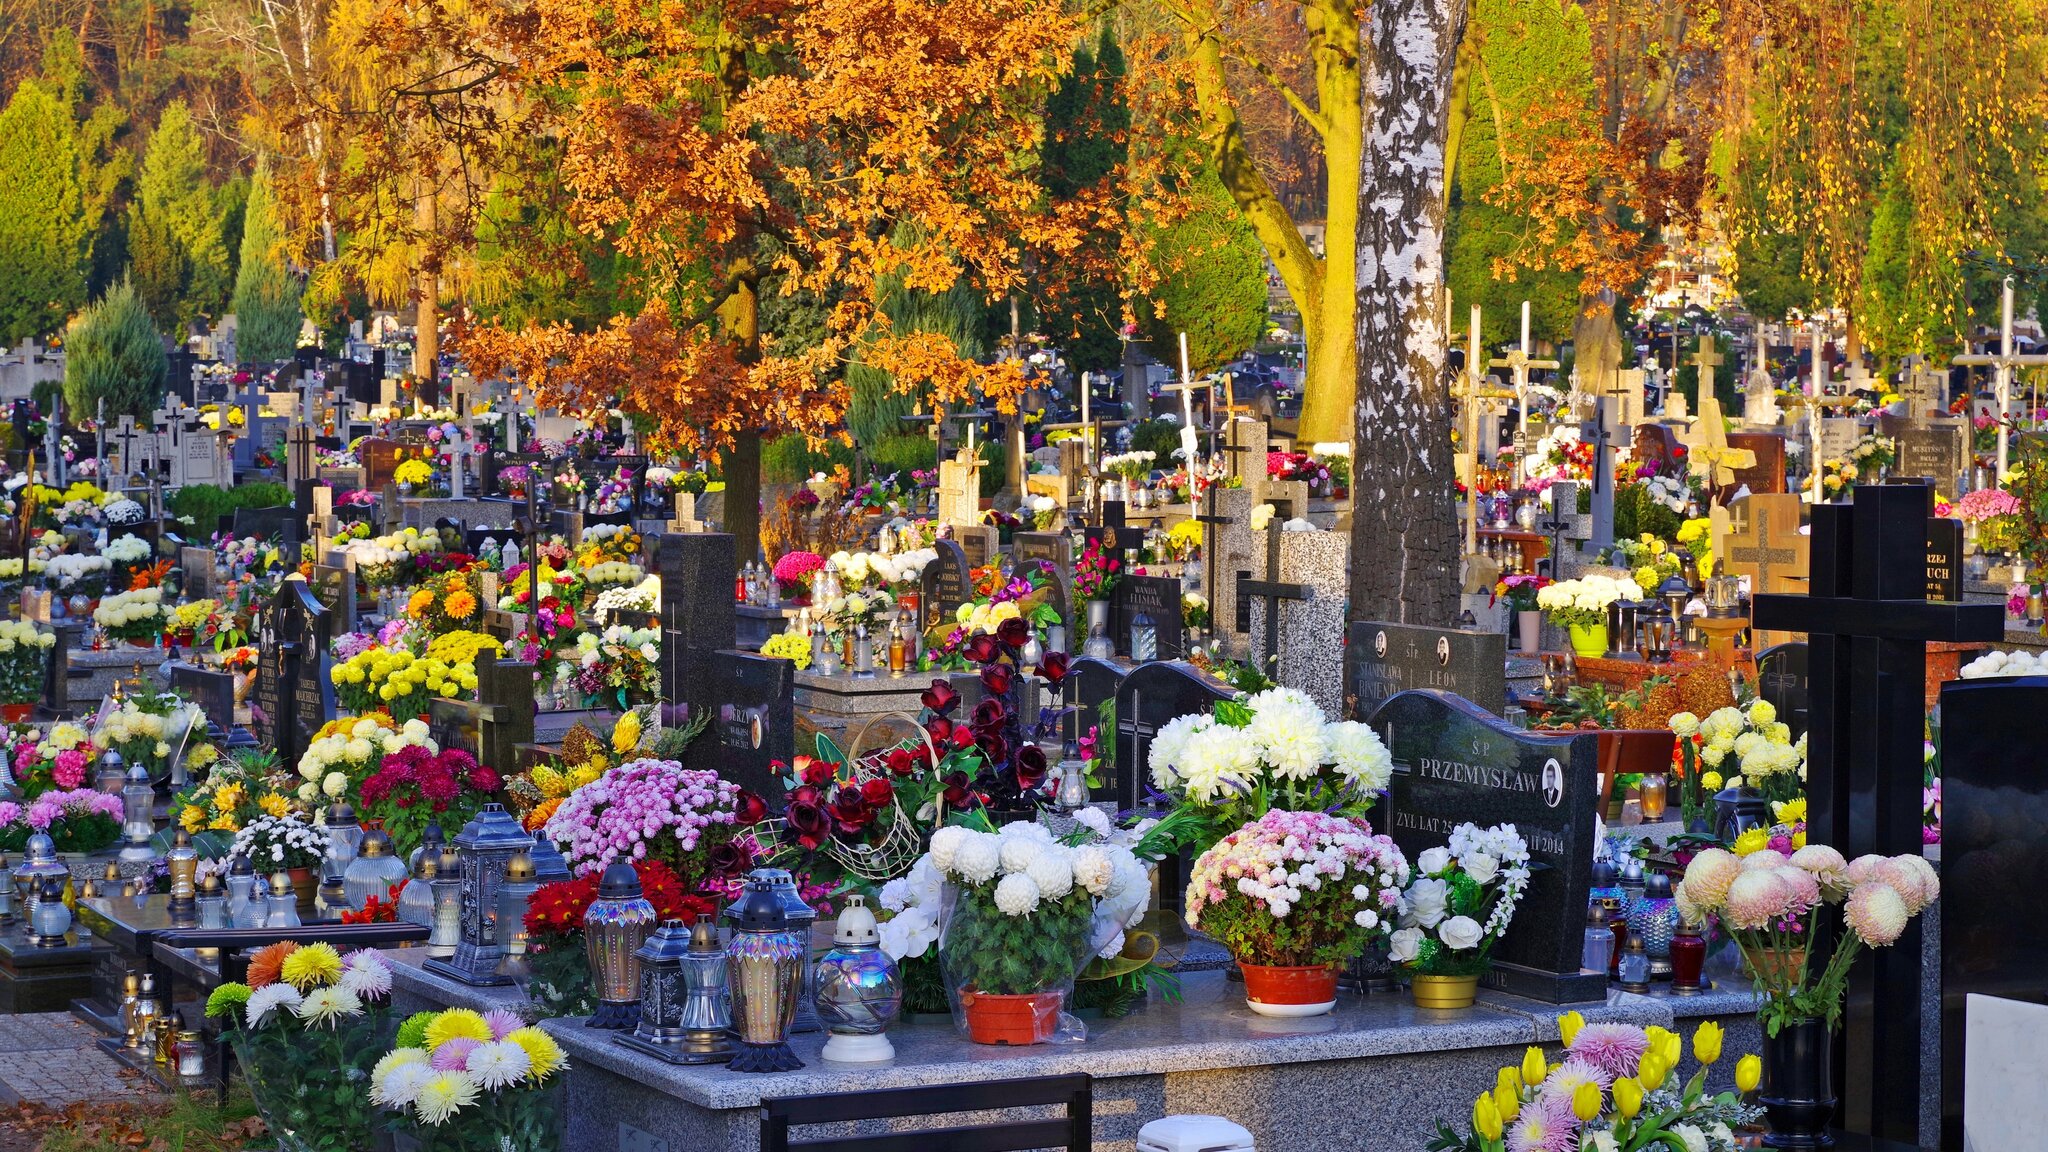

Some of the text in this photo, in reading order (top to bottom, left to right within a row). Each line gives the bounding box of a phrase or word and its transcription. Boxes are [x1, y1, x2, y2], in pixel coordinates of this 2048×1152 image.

[1926, 567, 1949, 580] UCH
[1134, 585, 1157, 595] WANDA
[1429, 670, 1457, 687] LEON
[729, 708, 749, 724] JERZY
[1420, 757, 1539, 793] PRZEMYSŁAW
[1396, 809, 1417, 829] ŻYŁ
[1419, 815, 1440, 833] LAT
[1541, 837, 1564, 856] 2014
